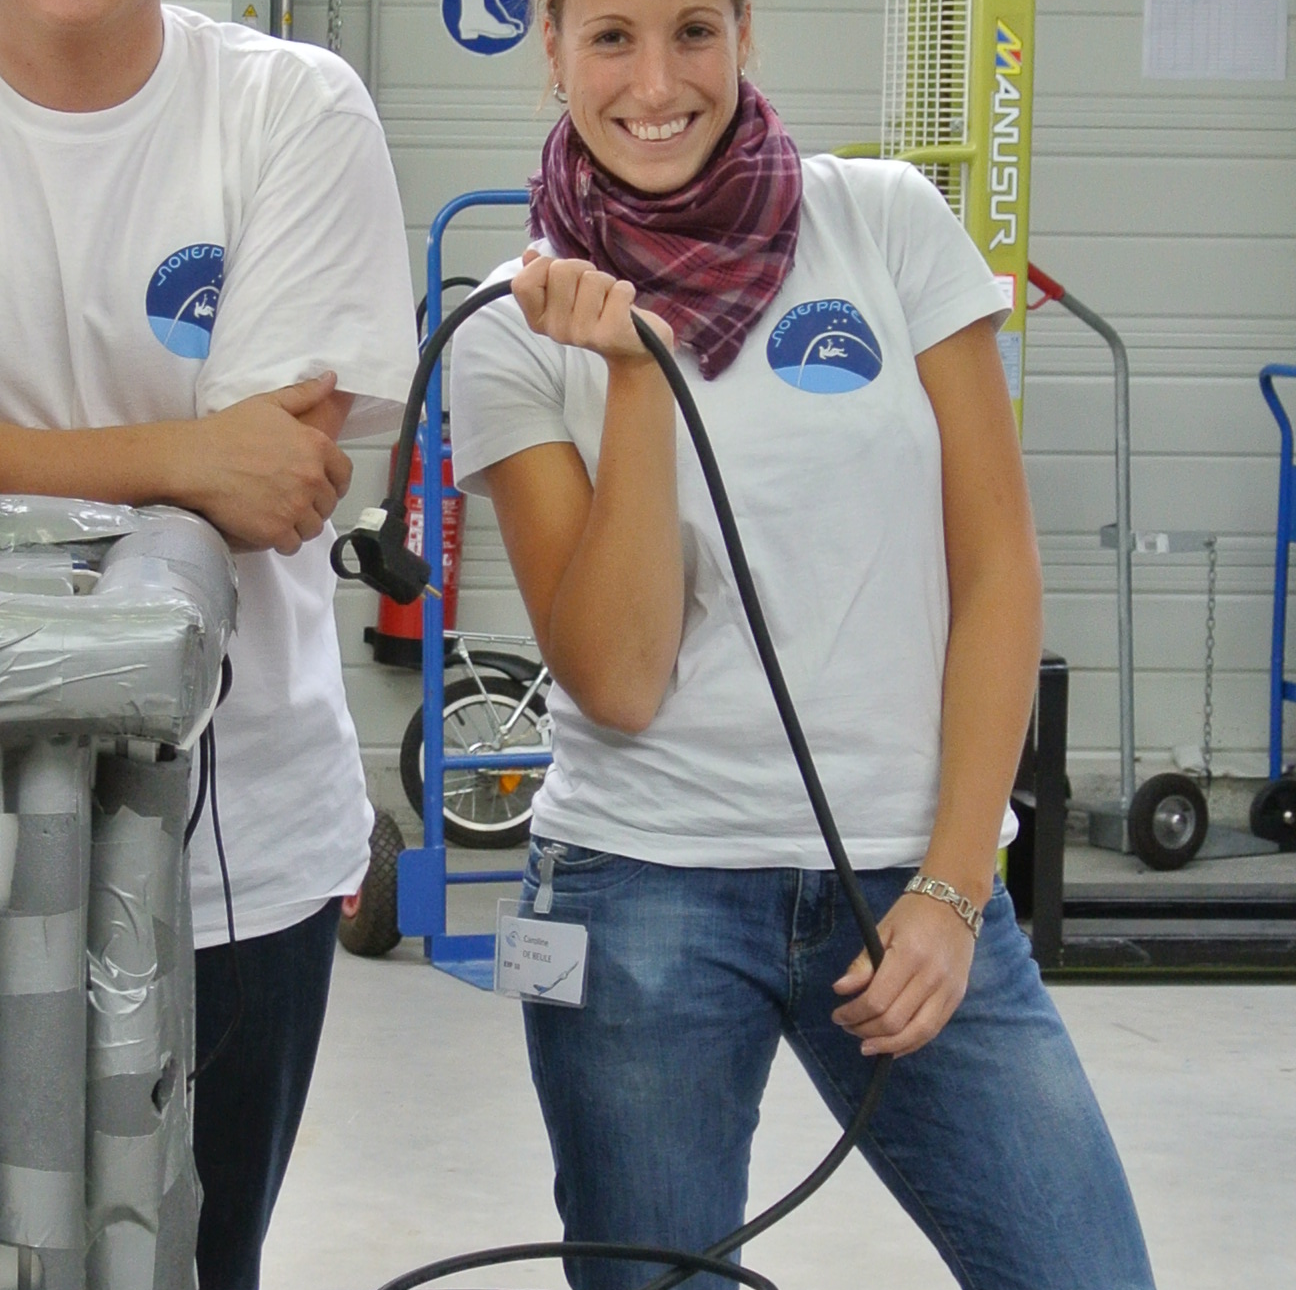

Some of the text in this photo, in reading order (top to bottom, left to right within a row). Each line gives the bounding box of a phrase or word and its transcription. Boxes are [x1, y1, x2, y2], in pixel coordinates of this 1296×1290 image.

[988, 17, 1023, 252] MANUSUR
[771, 300, 863, 348] NOVESPACE
[523, 935, 549, 946] Caroline
